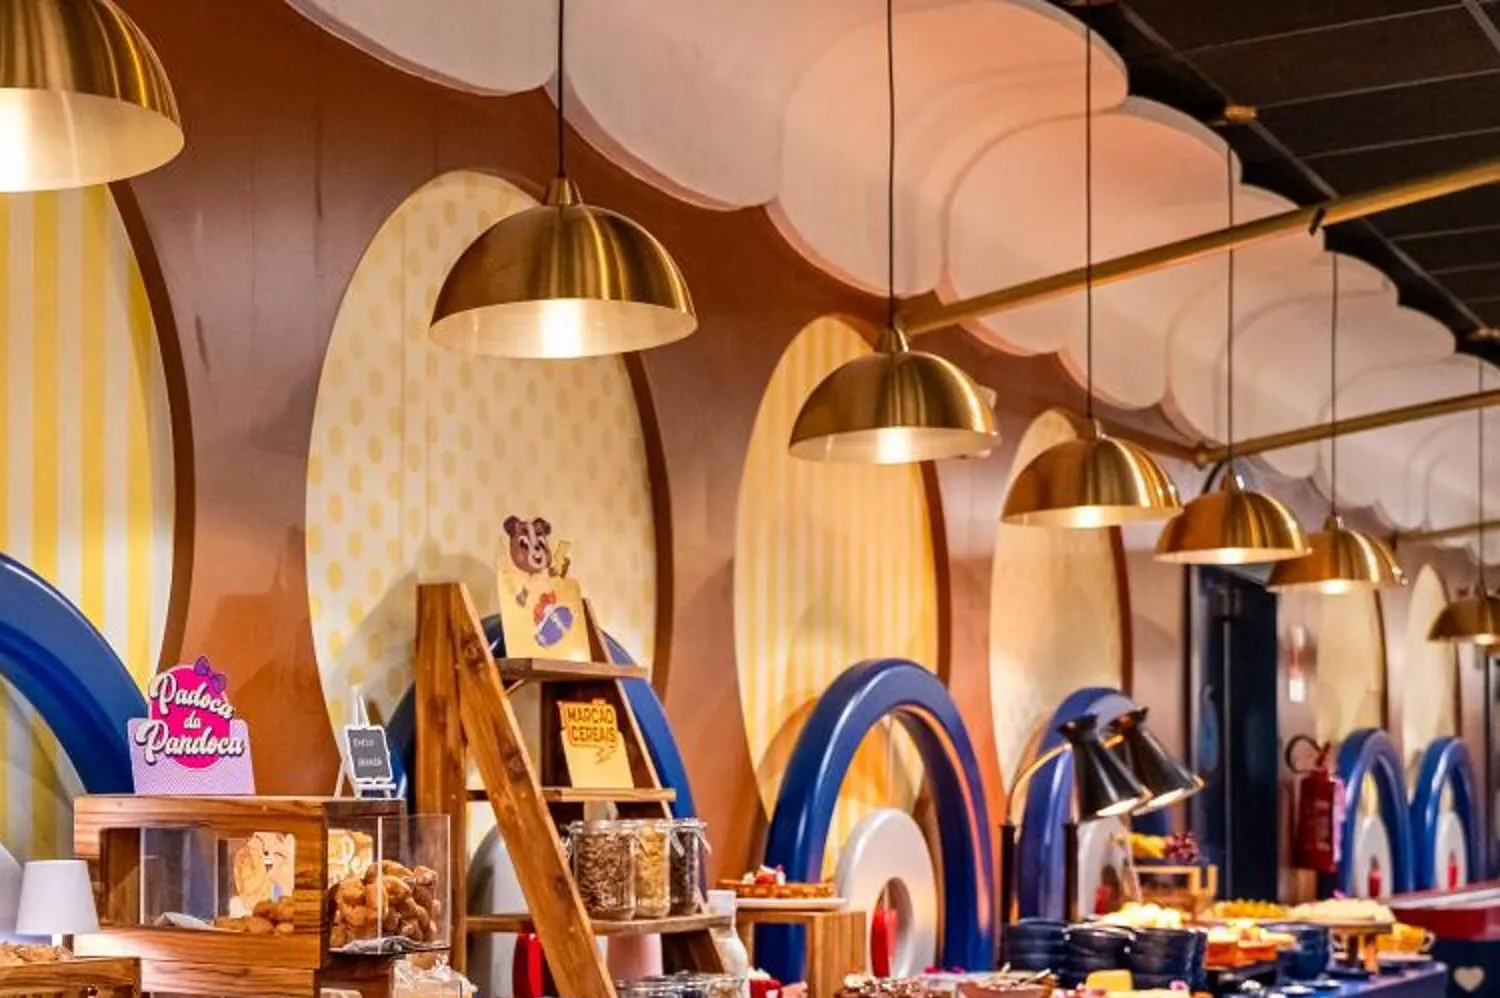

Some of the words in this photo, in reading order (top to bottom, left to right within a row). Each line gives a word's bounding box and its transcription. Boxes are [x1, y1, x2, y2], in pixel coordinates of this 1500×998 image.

[150, 672, 234, 717] Padoca
[183, 710, 202, 729] da
[135, 720, 245, 763] Pandoca
